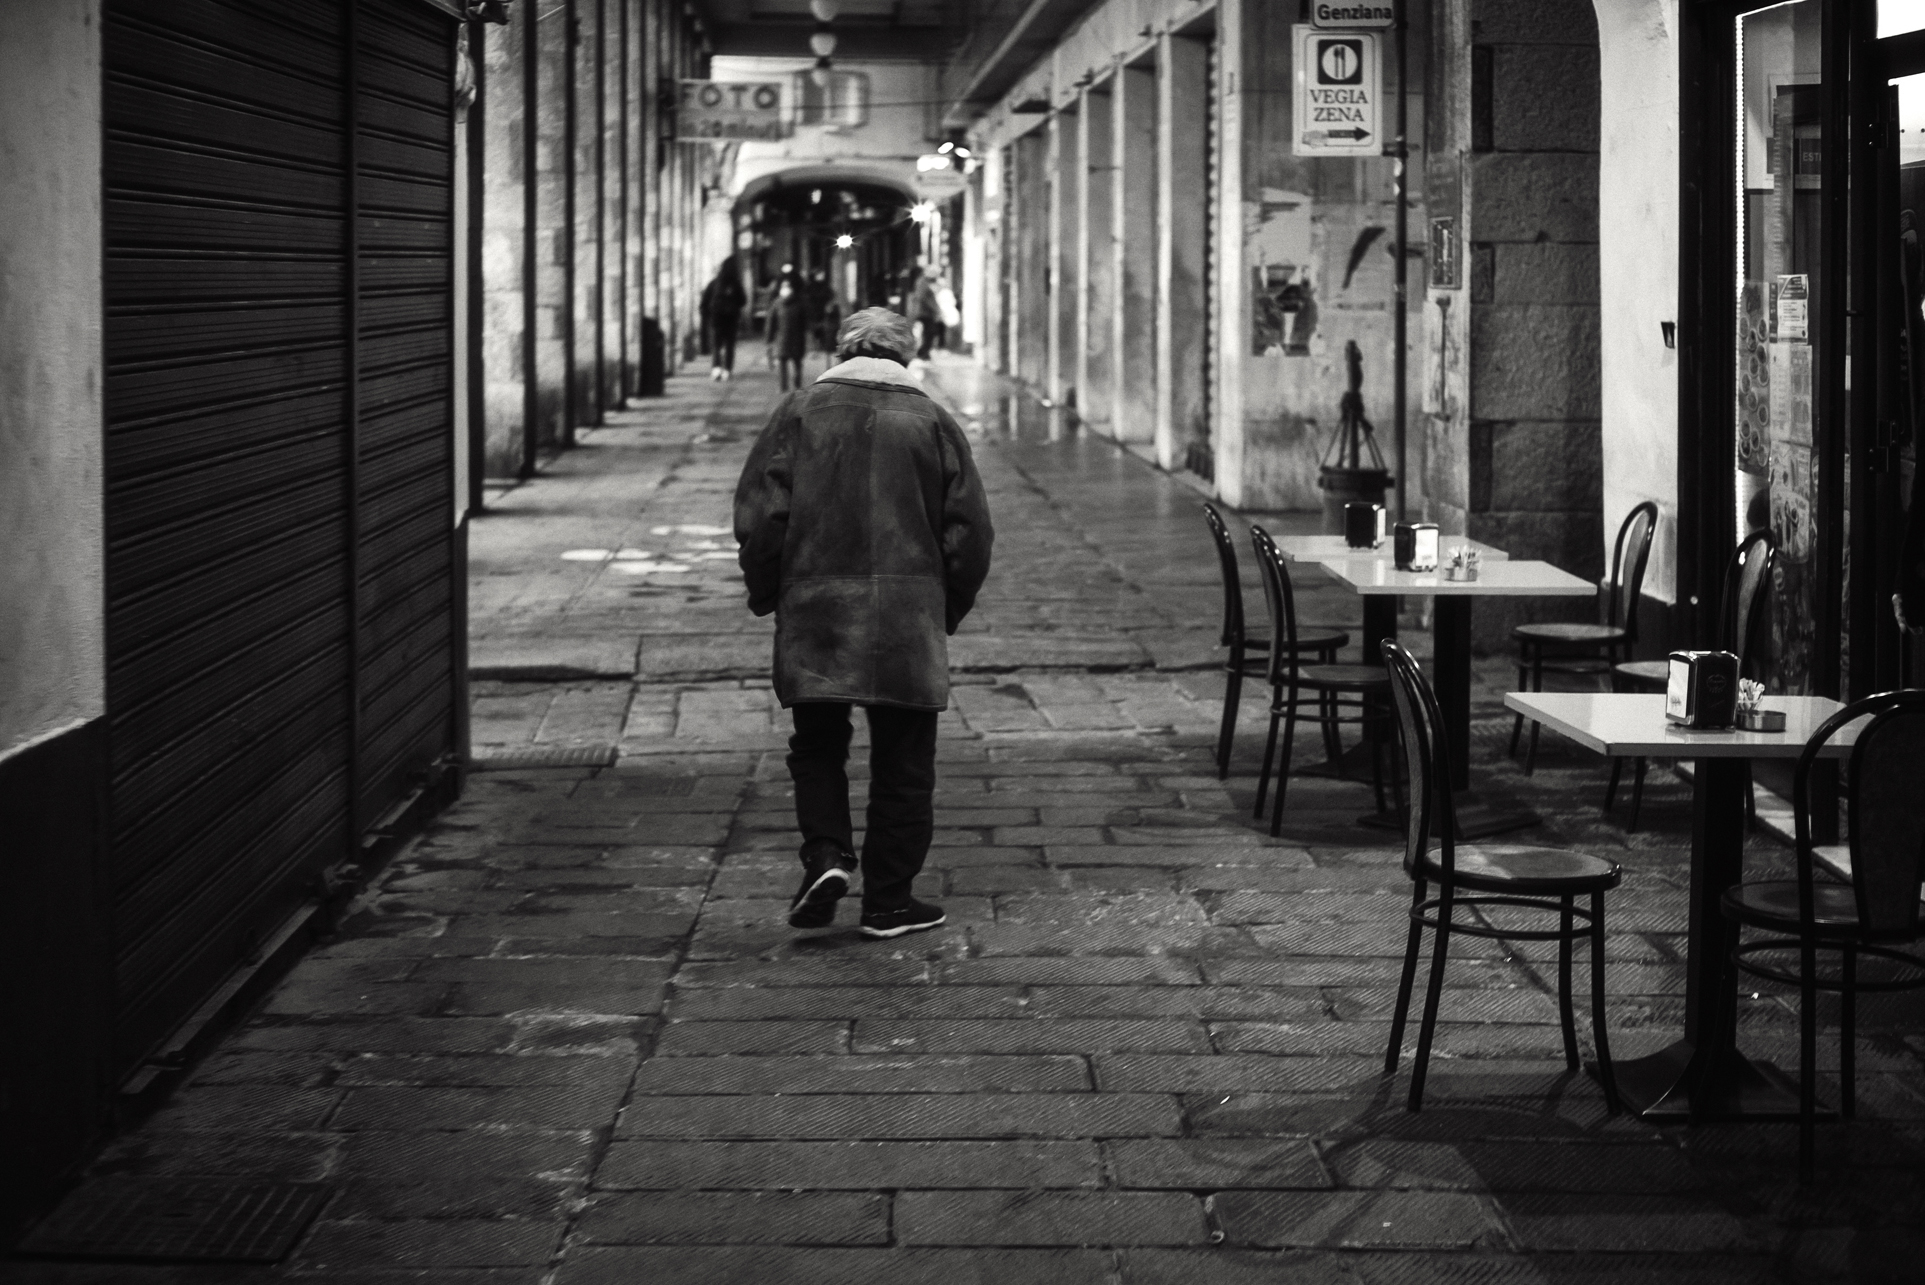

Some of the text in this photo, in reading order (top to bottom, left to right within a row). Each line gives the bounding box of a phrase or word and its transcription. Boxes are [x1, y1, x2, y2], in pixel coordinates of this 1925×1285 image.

[1318, 4, 1392, 20] Genziana
[1310, 89, 1368, 104] VEGIA
[1314, 107, 1364, 122] ZENA
